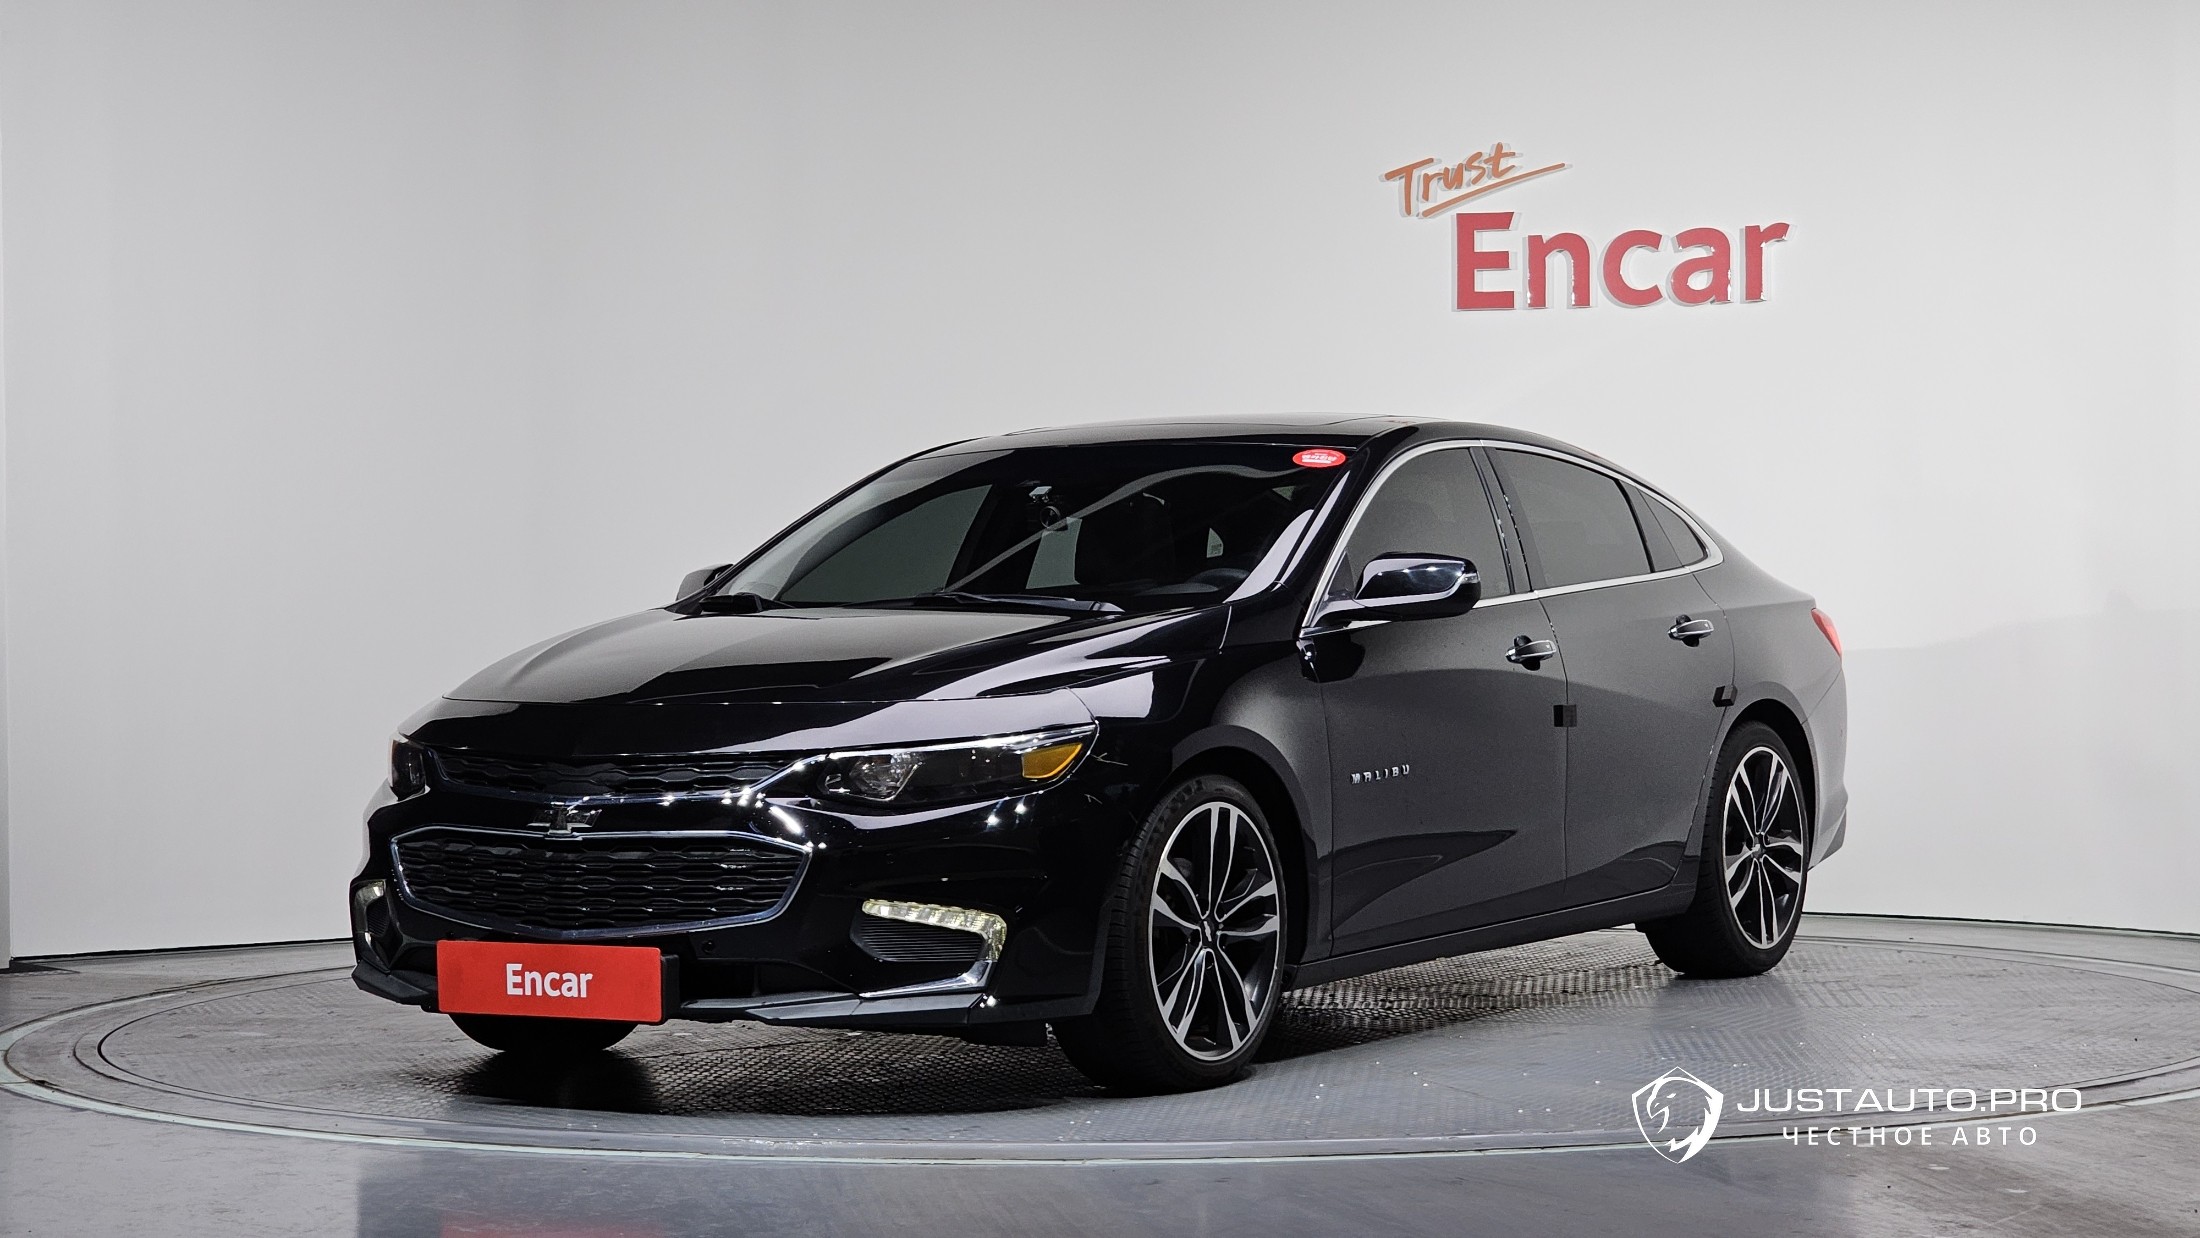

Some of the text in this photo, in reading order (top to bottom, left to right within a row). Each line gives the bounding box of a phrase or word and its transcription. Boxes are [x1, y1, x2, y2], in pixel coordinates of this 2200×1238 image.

[1384, 142, 1517, 216] Trust
[1455, 211, 1792, 310] Encar
[1350, 764, 1410, 784] MALIBU
[505, 963, 594, 998] Encar
